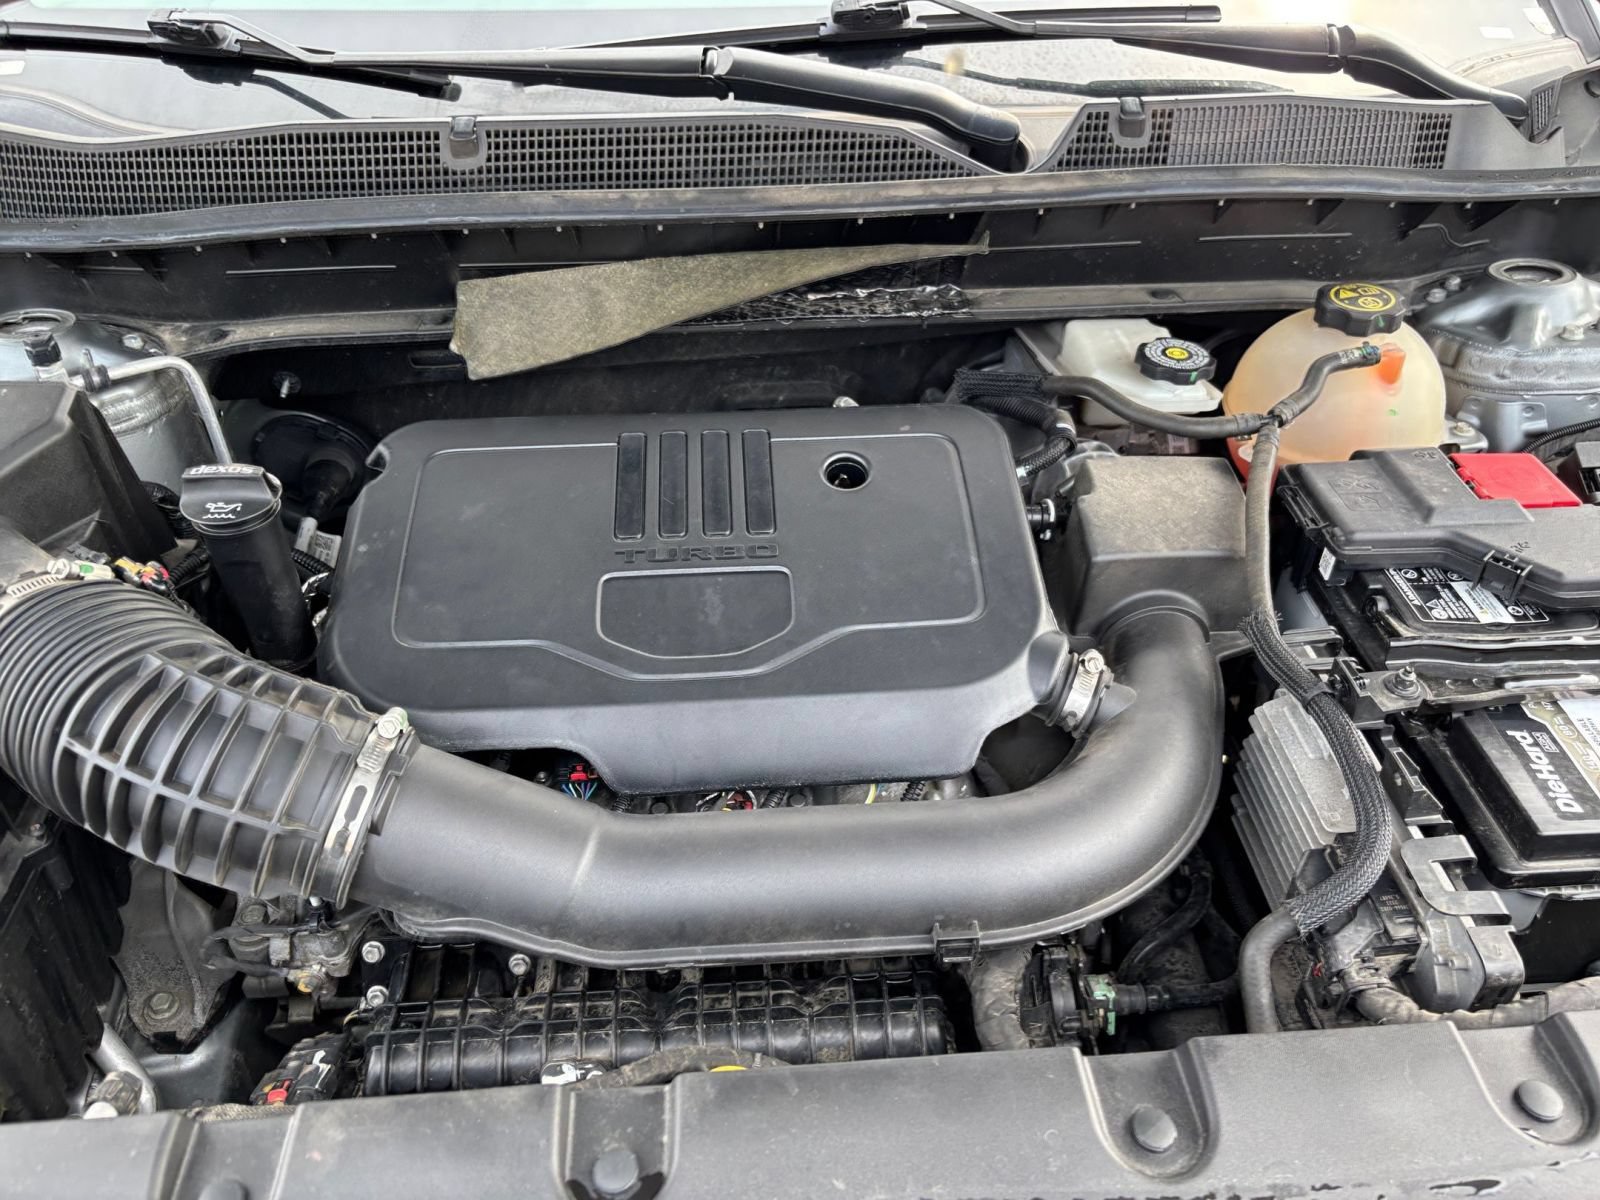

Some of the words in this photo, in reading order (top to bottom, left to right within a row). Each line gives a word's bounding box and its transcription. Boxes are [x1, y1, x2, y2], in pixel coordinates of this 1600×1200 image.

[189, 464, 254, 475] dexos
[614, 543, 779, 564] TURBO
[1505, 730, 1584, 813] DieHard
